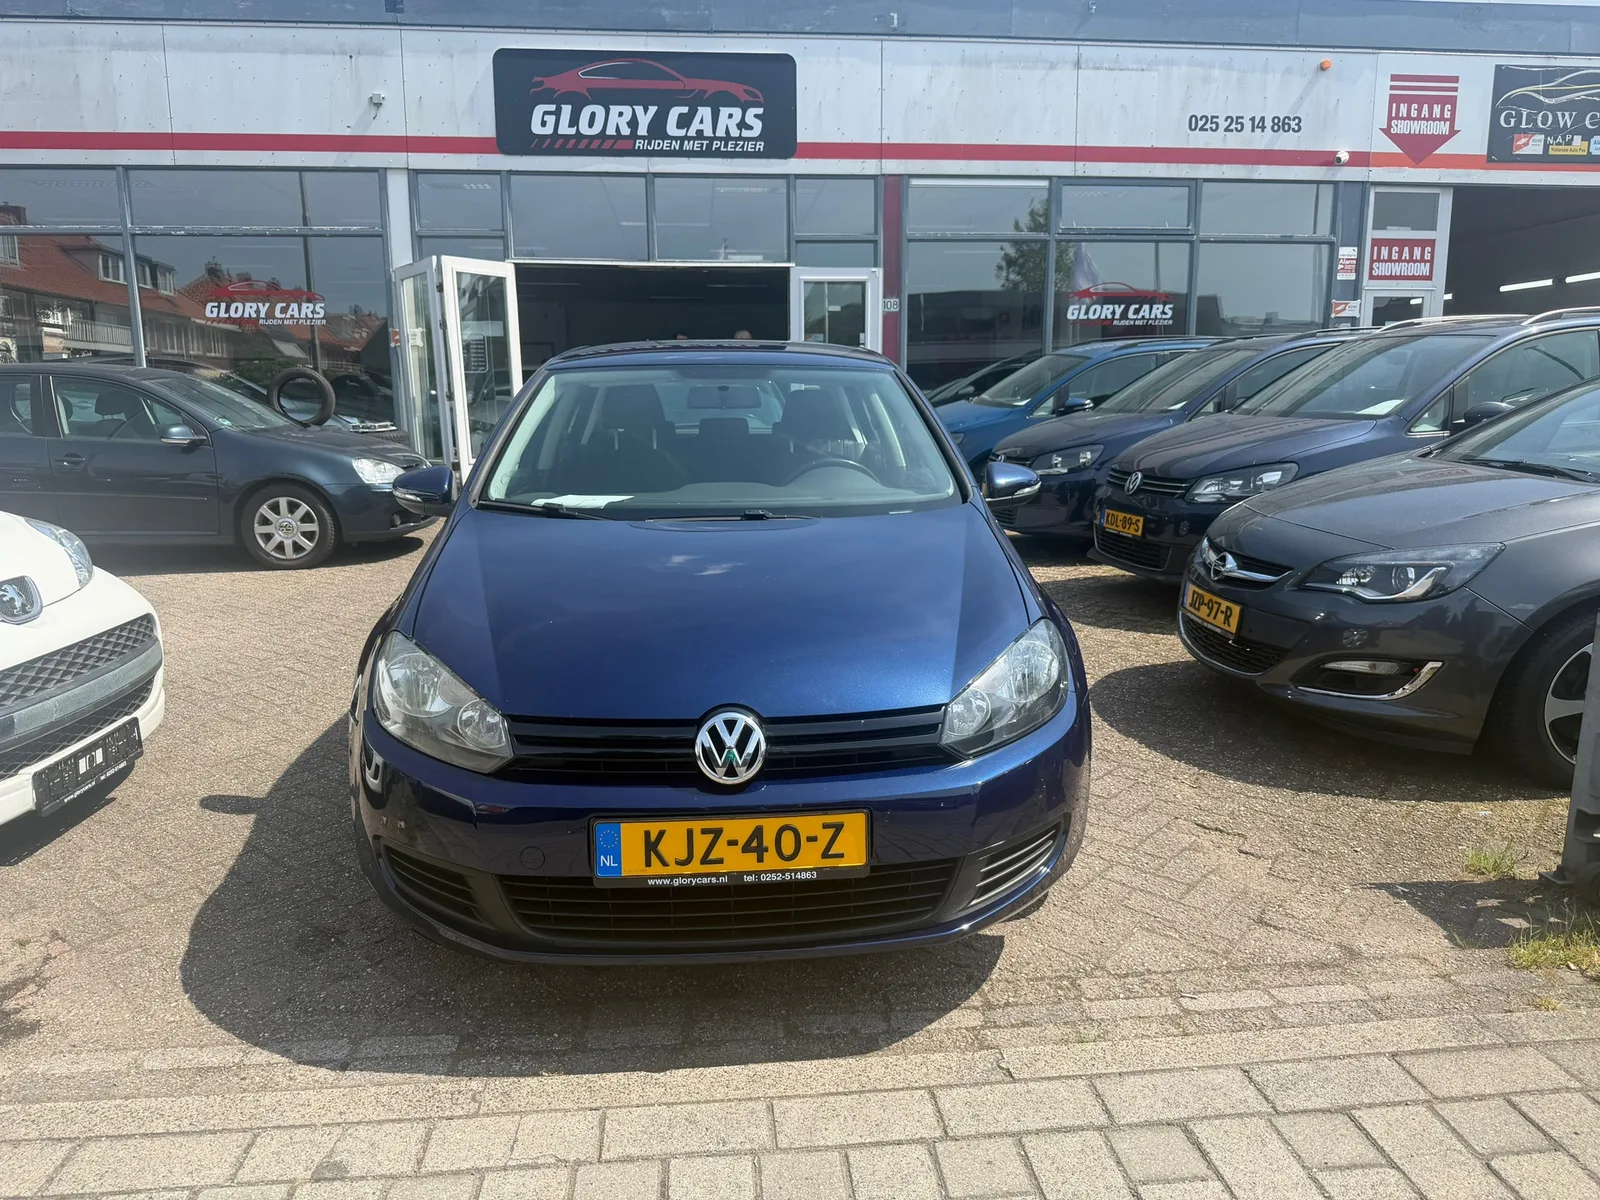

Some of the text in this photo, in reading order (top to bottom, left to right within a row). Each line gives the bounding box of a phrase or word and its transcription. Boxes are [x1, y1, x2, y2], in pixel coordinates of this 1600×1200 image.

[1392, 103, 1451, 118] INGANG
[530, 104, 764, 138] GLORY CARS
[1188, 114, 1302, 133] 025 25 14 863
[1390, 119, 1450, 135] SHOWROOM
[1500, 110, 1577, 129] GLOW
[635, 139, 765, 152] RIJDEN MET PLEZIER
[1373, 246, 1431, 260] INGANG
[1372, 262, 1430, 276] SHOWROOM
[205, 302, 325, 318] GLORY CARS
[883, 300, 899, 310] 108
[1066, 304, 1174, 320] GLORY CARS
[1105, 511, 1140, 532] KDL-89-S
[1189, 589, 1233, 627] JZP-97-R
[643, 821, 845, 867] KJZ-40-Z
[600, 855, 618, 867] NL
[648, 871, 817, 886] www.glorycars.nl tel: 0252-514863
